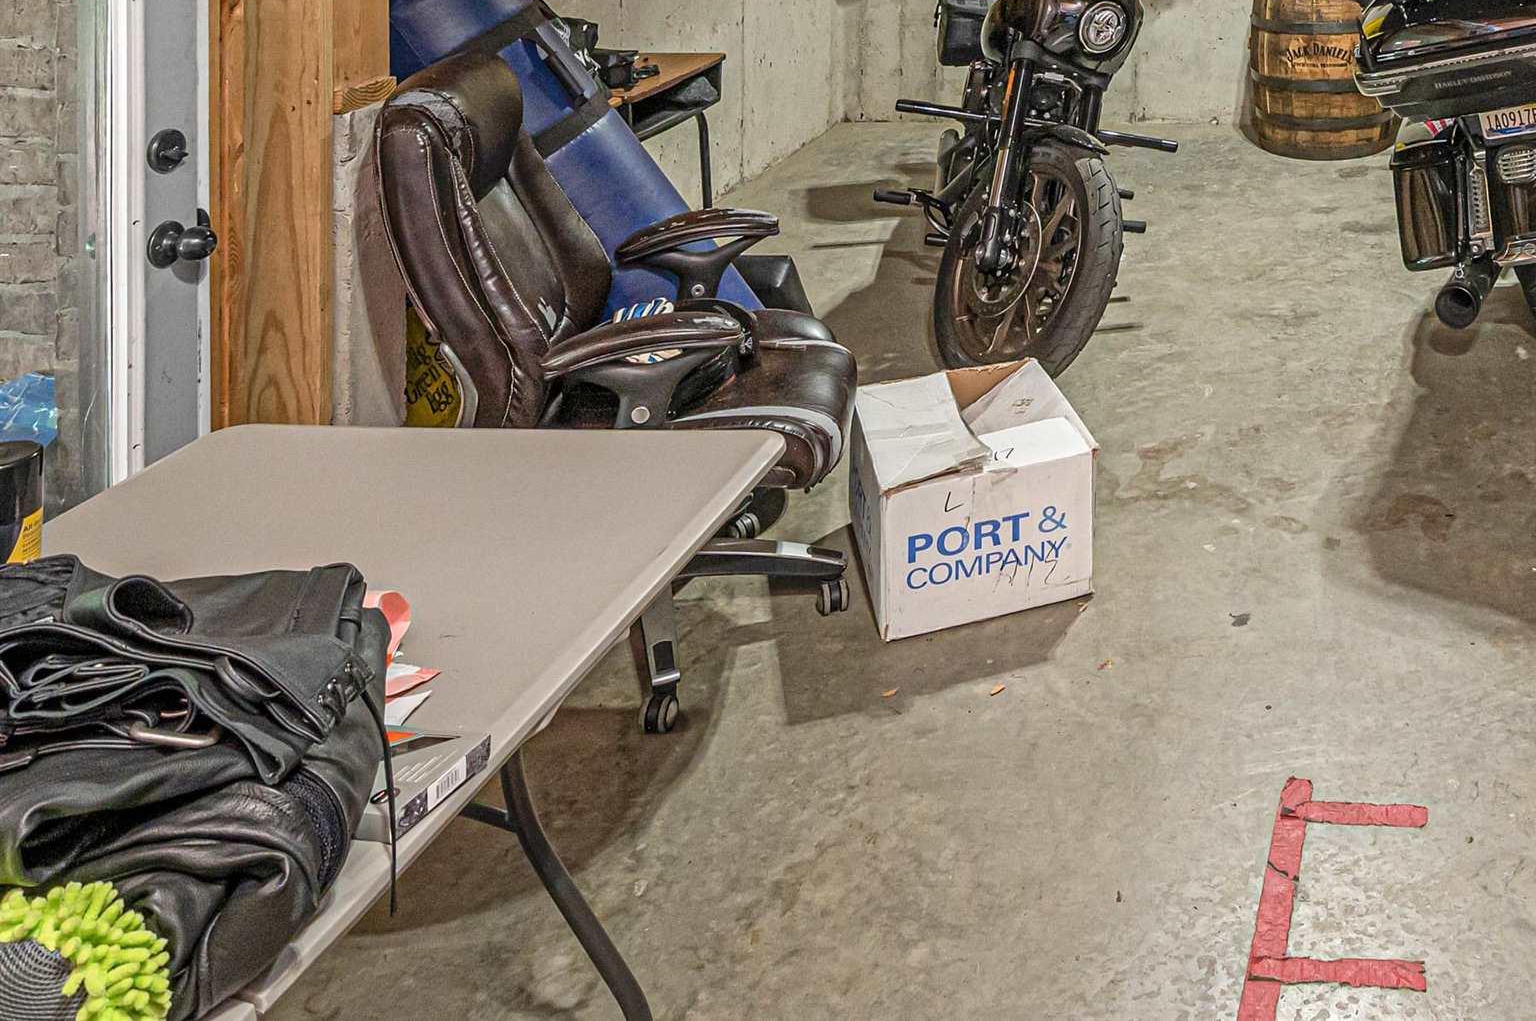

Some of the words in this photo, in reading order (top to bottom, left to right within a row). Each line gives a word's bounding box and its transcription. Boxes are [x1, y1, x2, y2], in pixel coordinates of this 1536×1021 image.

[426, 381, 454, 415] Egg
[907, 512, 1030, 564] PORT
[1038, 505, 1068, 533] &
[906, 537, 1068, 590] COMPANY
